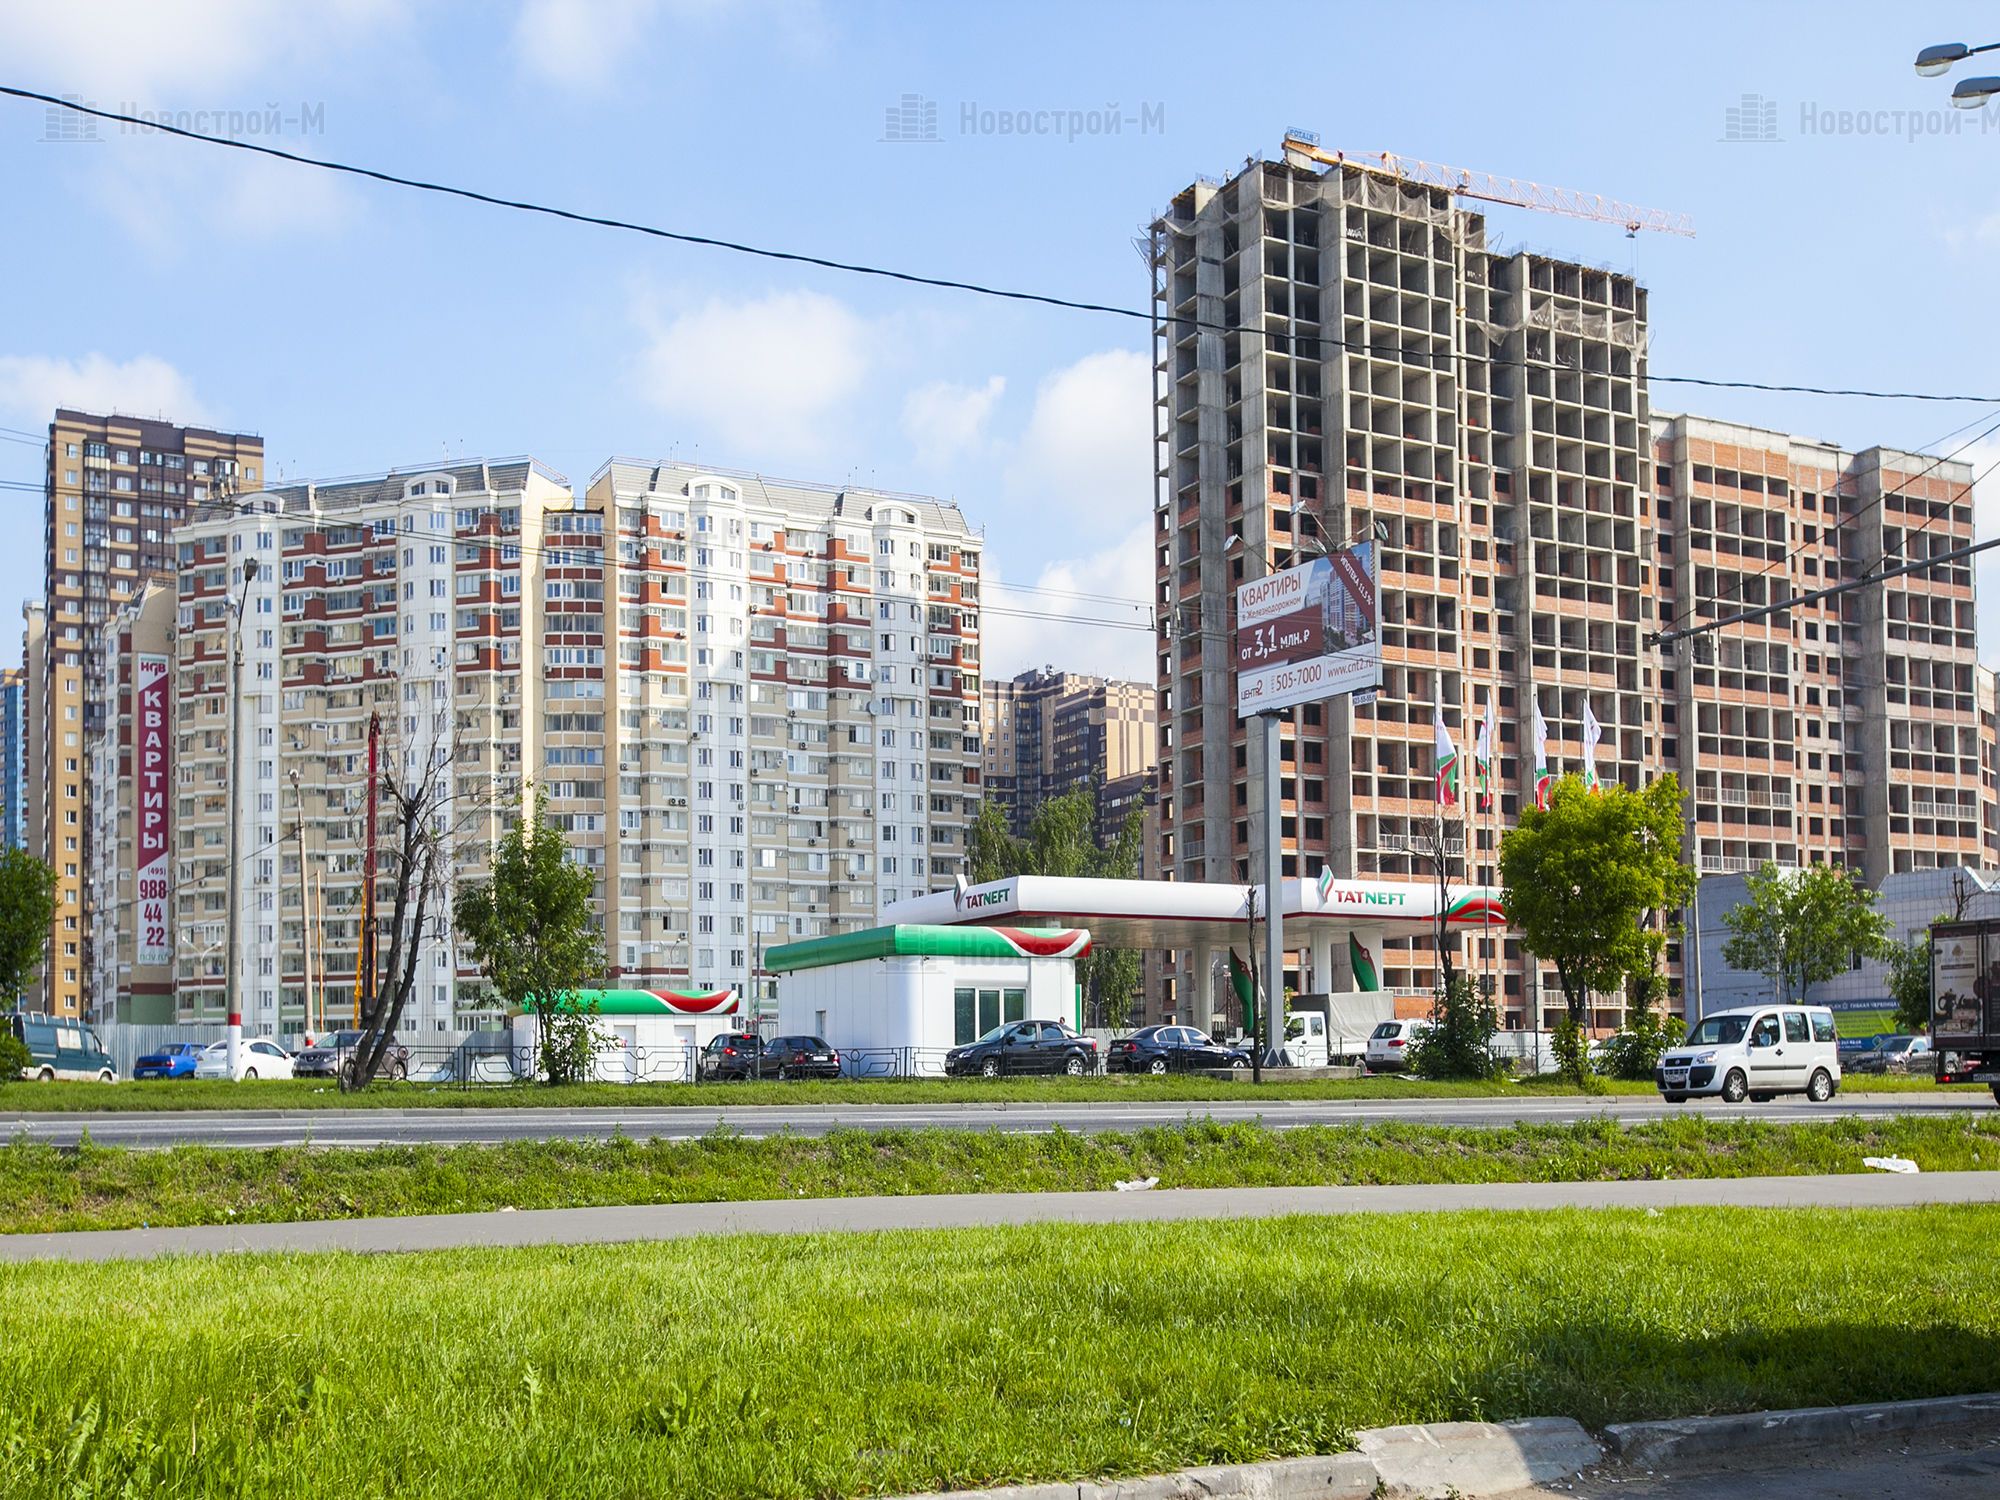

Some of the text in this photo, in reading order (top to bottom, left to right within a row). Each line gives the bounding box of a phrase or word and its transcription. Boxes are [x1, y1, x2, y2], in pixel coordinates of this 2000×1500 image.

[1340, 555, 1360, 587] ИПОТЕКА
[1241, 571, 1301, 609] КВАРТИРЫ
[1241, 647, 1253, 660] от
[1255, 624, 1278, 659] 3,1
[1275, 663, 1322, 692] 505-7000
[143, 690, 164, 849] КВАРТИРЫ
[147, 867, 167, 876] (495)
[140, 879, 167, 900] 988
[965, 888, 1010, 909] TATNEFT
[1335, 889, 1406, 906] TATNEFT
[144, 903, 163, 923] 44
[146, 926, 165, 947] 22
